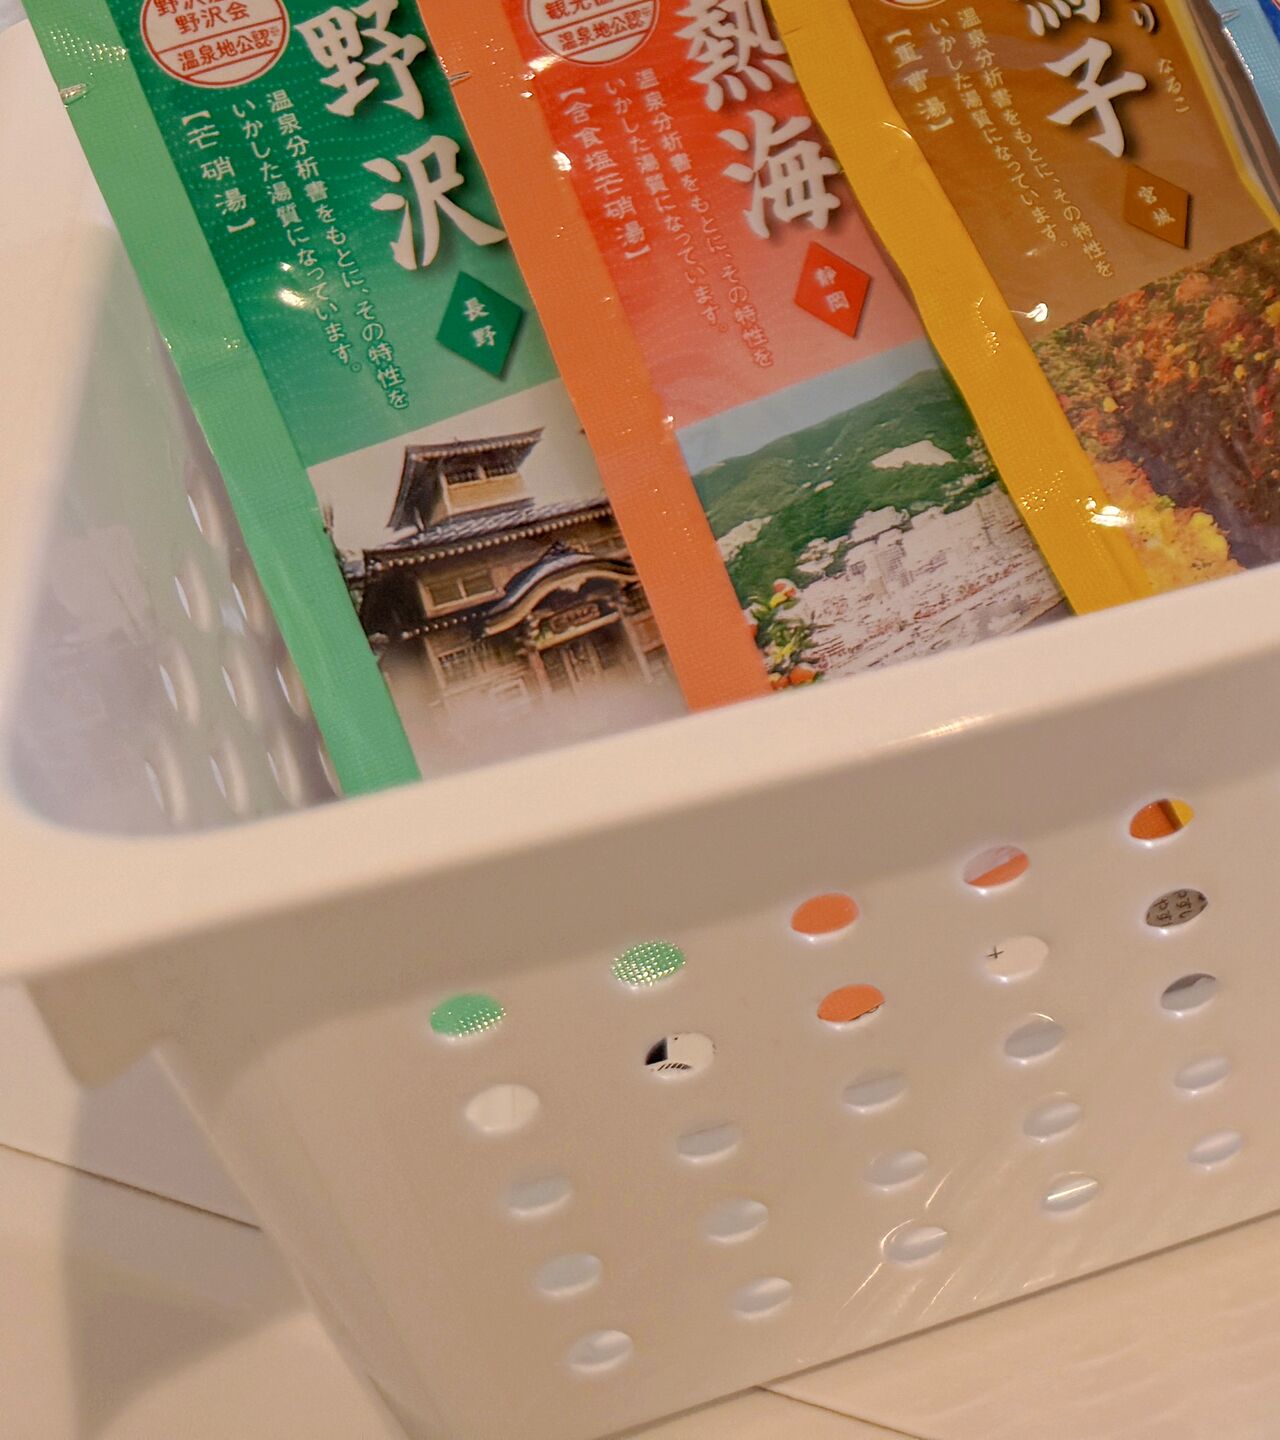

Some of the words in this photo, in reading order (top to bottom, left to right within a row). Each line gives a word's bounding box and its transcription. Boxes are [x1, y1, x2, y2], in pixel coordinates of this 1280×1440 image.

[175, 1, 250, 35] 野沢会
[1156, 57, 1190, 115] なるこ
[1137, 184, 1176, 228] 宮城
[462, 296, 497, 349] 長野
